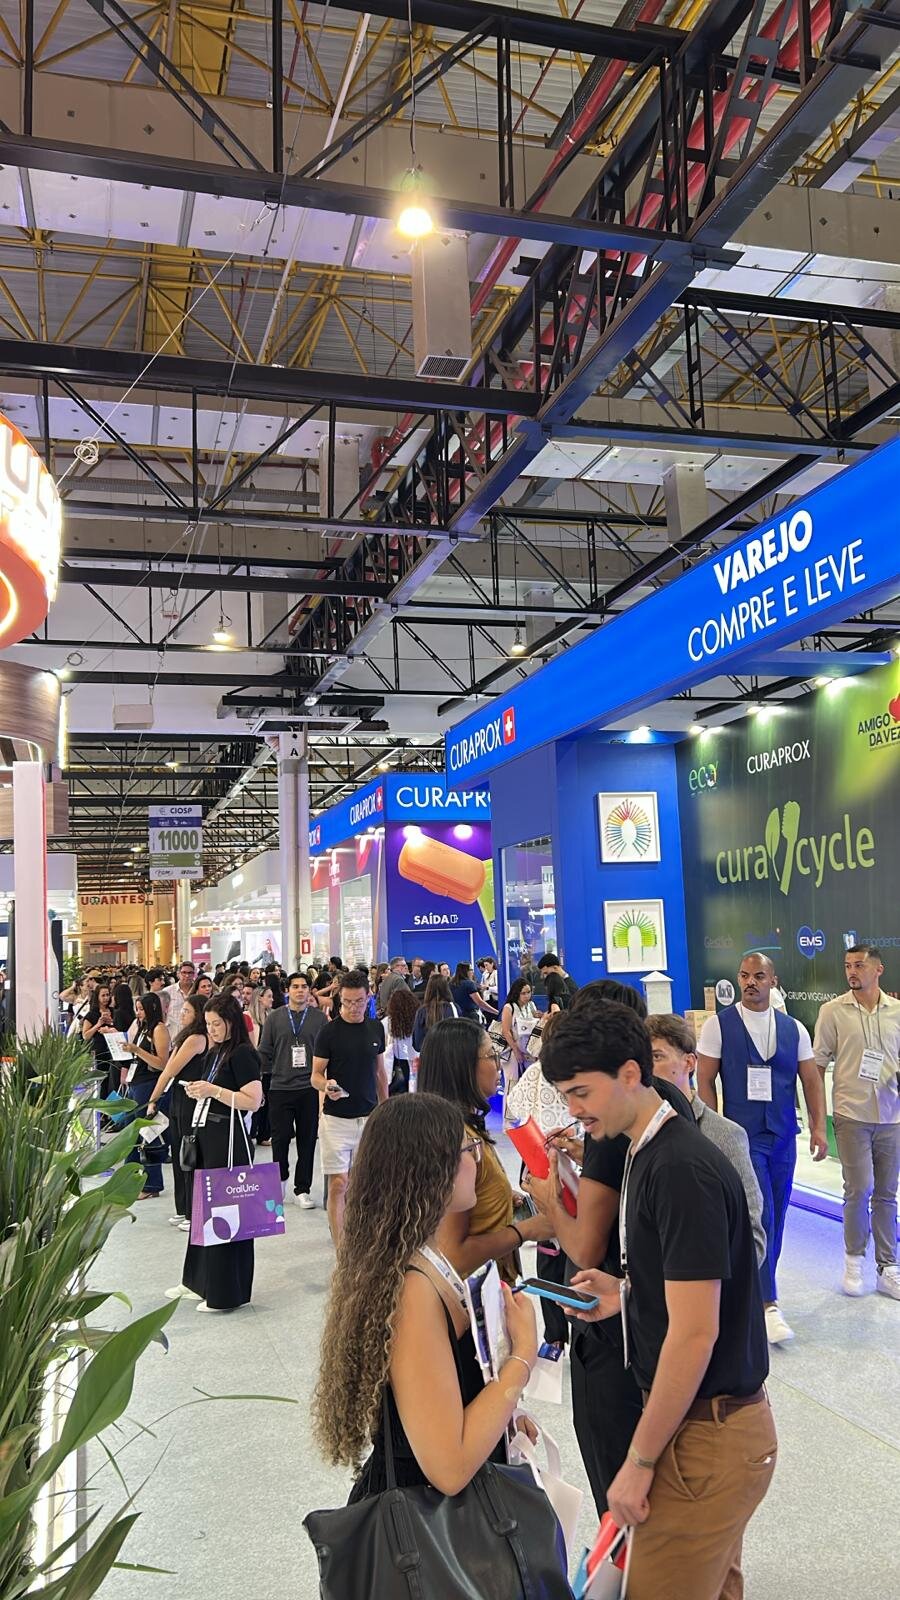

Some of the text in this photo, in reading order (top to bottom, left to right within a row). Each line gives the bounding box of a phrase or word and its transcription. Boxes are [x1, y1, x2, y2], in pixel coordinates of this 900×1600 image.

[713, 510, 813, 595] VAREJO
[687, 538, 866, 661] COMPRE E LEVE
[857, 713, 891, 735] AMIGO
[450, 718, 502, 771] CURAPROX
[869, 731, 883, 747] DA
[746, 740, 811, 774] CURAPROX
[396, 786, 490, 808] CURAPR
[158, 830, 199, 851] 11000
[796, 813, 875, 888] cycle
[414, 912, 450, 925] SAÍDA
[799, 936, 823, 947] EMS
[788, 991, 807, 1000] GRUPO
[226, 1184, 260, 1195] OralUnic
